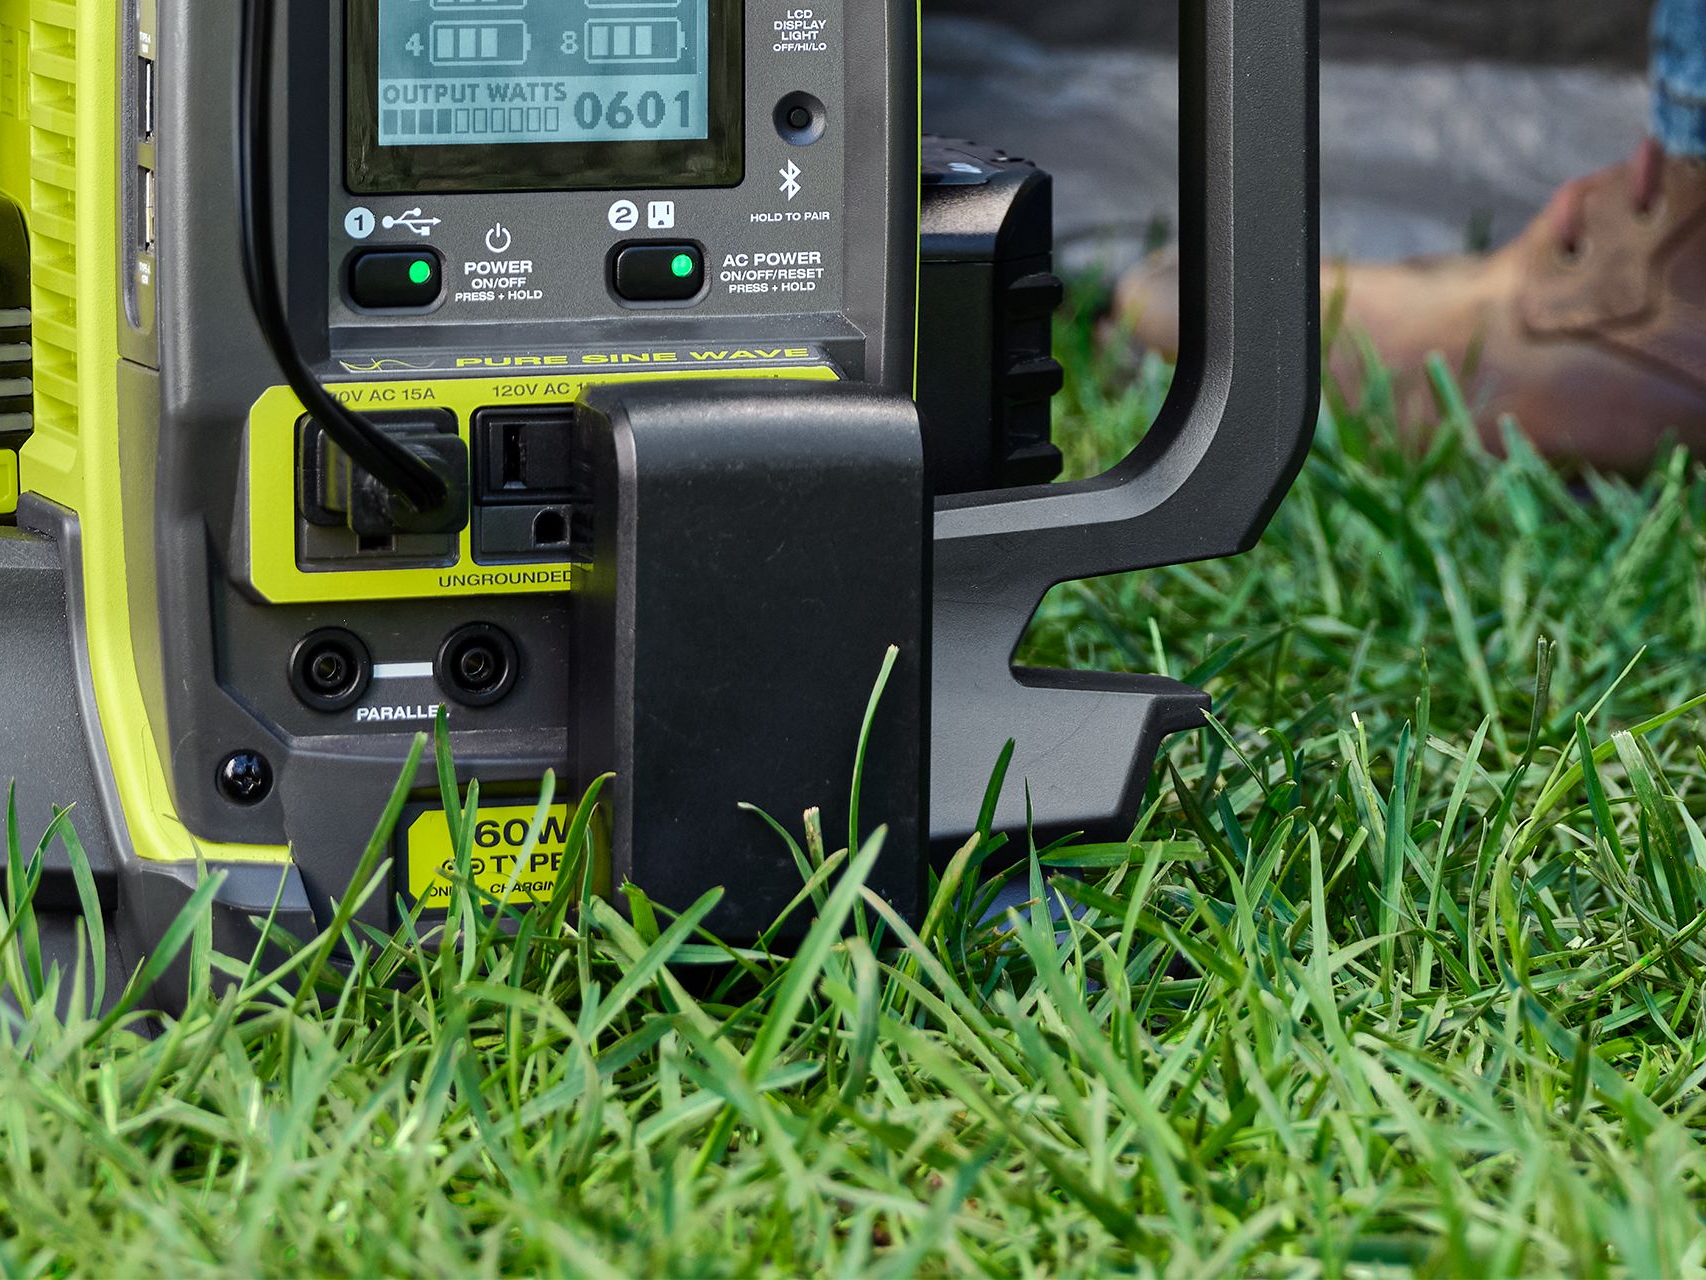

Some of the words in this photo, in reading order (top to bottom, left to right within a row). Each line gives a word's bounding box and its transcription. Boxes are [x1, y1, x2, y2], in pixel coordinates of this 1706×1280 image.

[787, 9, 813, 19] LCD
[774, 20, 827, 30] DISPLAY
[560, 31, 579, 54] 8
[782, 31, 819, 41] LIGHT
[405, 32, 424, 56] 4
[773, 42, 827, 51] OFF/HI/LO
[383, 83, 480, 104] OUTPUT
[487, 82, 568, 103] WATTS
[574, 90, 691, 130] 0601
[615, 206, 632, 223] 2
[750, 213, 783, 222] HOLD
[785, 212, 801, 221] TO
[804, 211, 830, 220] PAIR
[723, 255, 749, 267] AC
[753, 252, 822, 266] POWER
[464, 260, 533, 275] POWER
[720, 268, 824, 282] ON/OFF/RESET
[471, 277, 527, 289] ON/OFF
[729, 283, 769, 293] PRESS
[781, 282, 816, 292] HOLD
[455, 291, 495, 302] PRESS
[508, 290, 543, 300] HOLD
[456, 356, 568, 367] PURE
[581, 352, 678, 364] SINE
[690, 348, 809, 360] WAVE
[369, 389, 395, 401] AC
[402, 388, 435, 401] 15A
[493, 384, 538, 397] 120V
[544, 383, 570, 395] AC
[357, 705, 450, 721] PARALLE
